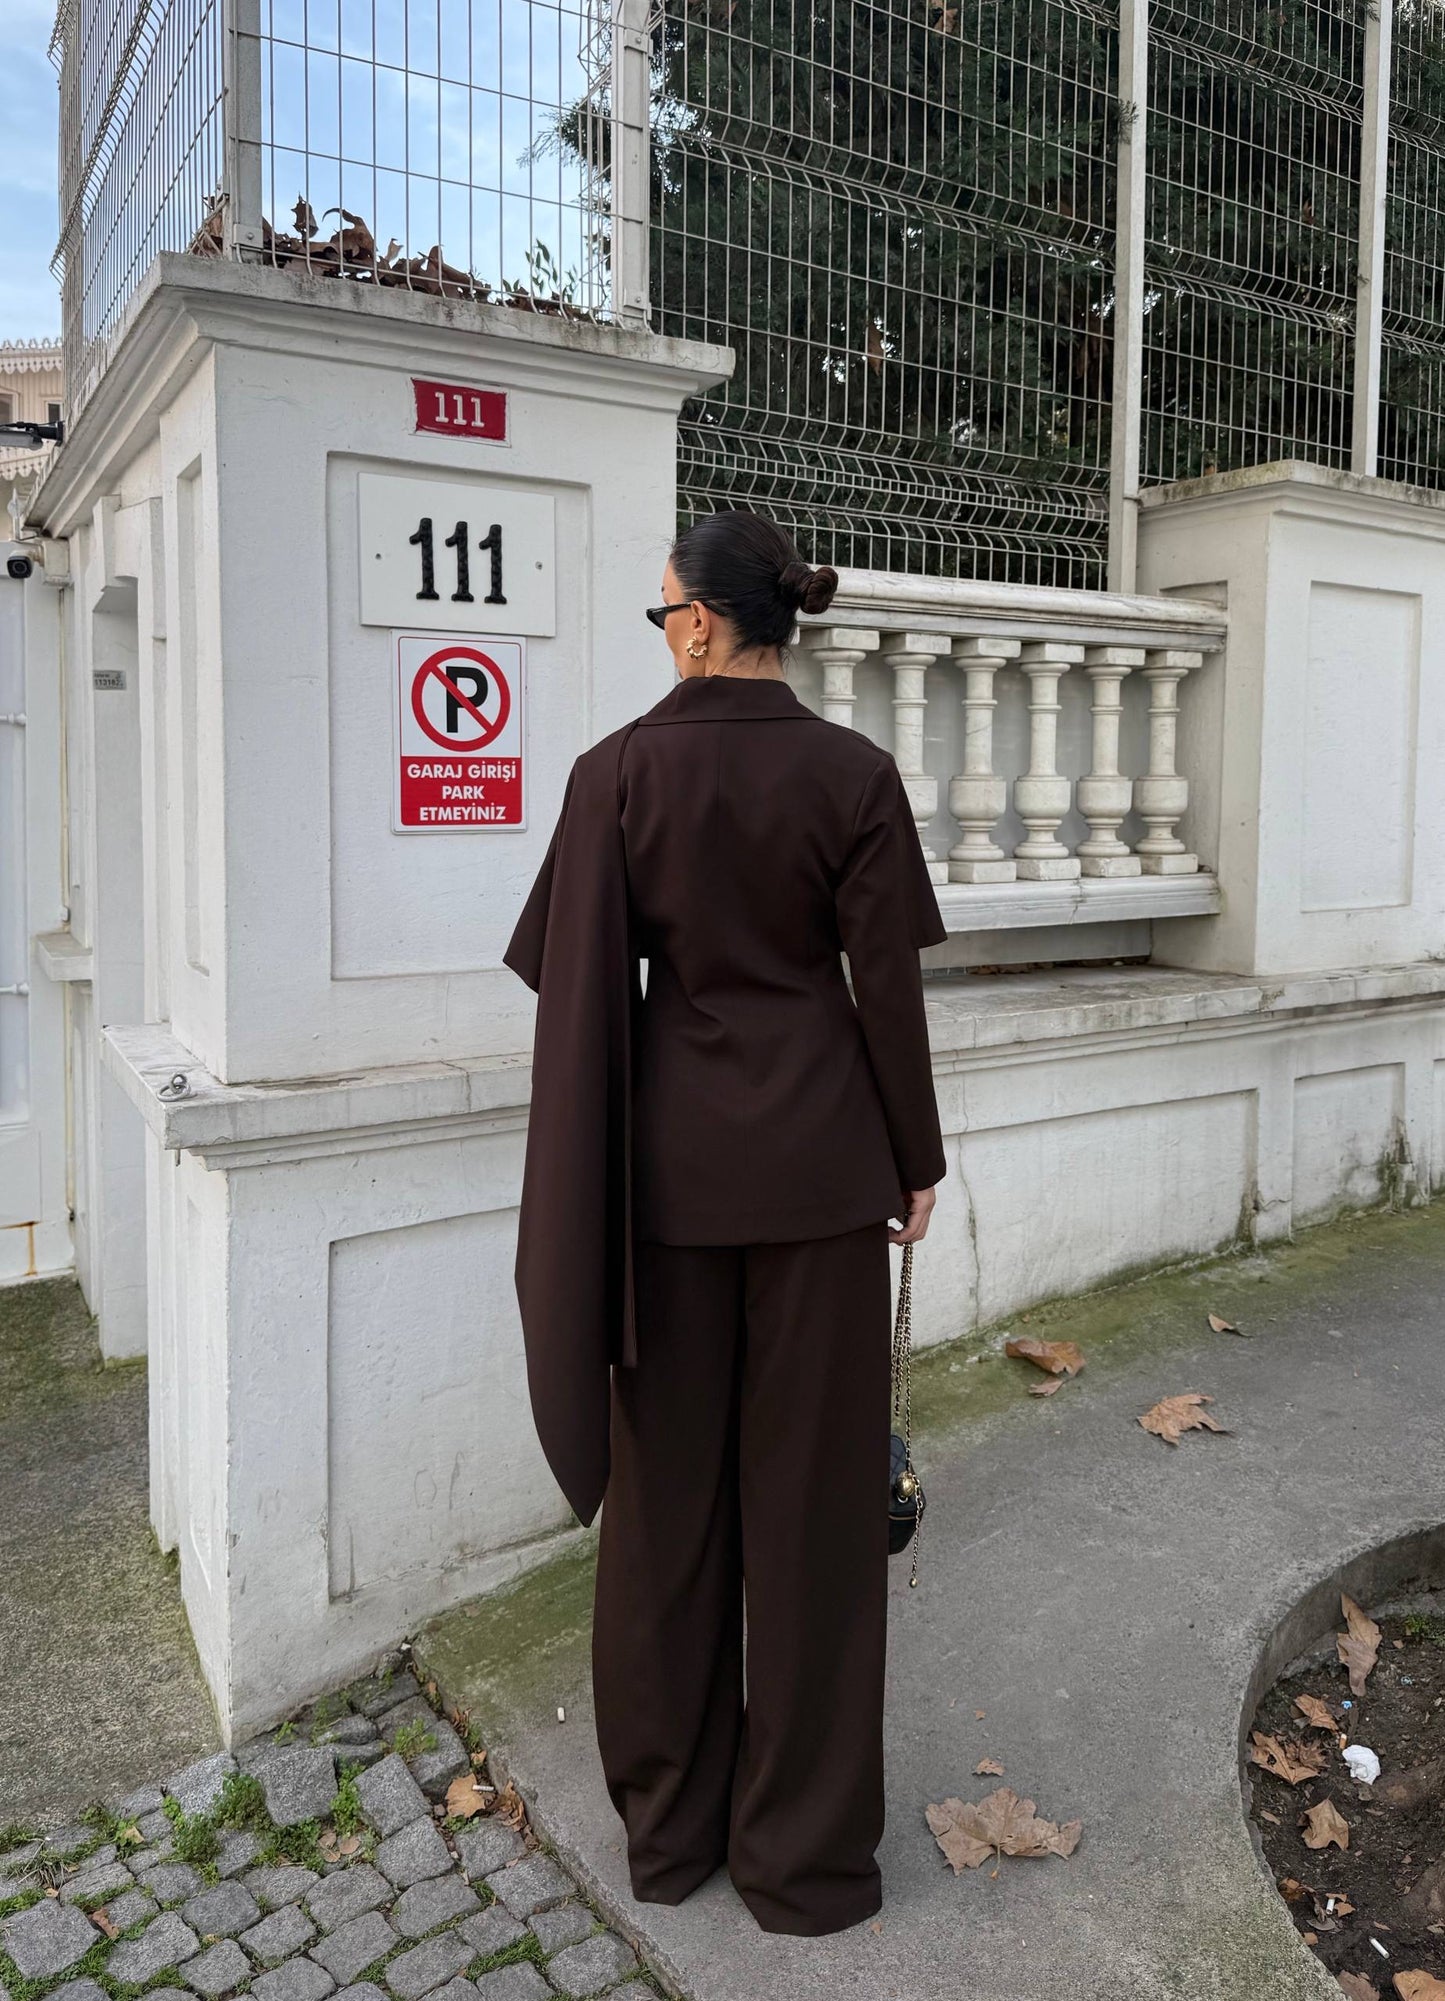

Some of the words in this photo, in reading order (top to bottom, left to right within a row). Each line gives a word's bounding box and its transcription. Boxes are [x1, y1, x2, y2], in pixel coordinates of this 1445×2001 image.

[435, 391, 485, 427] 111
[409, 517, 508, 605] 111
[446, 666, 489, 733] P
[407, 763, 463, 779] GARAJ
[467, 760, 517, 783] GİRİŞİ
[442, 785, 485, 800] PARK
[419, 802, 507, 821] ETMEYİNİZ
